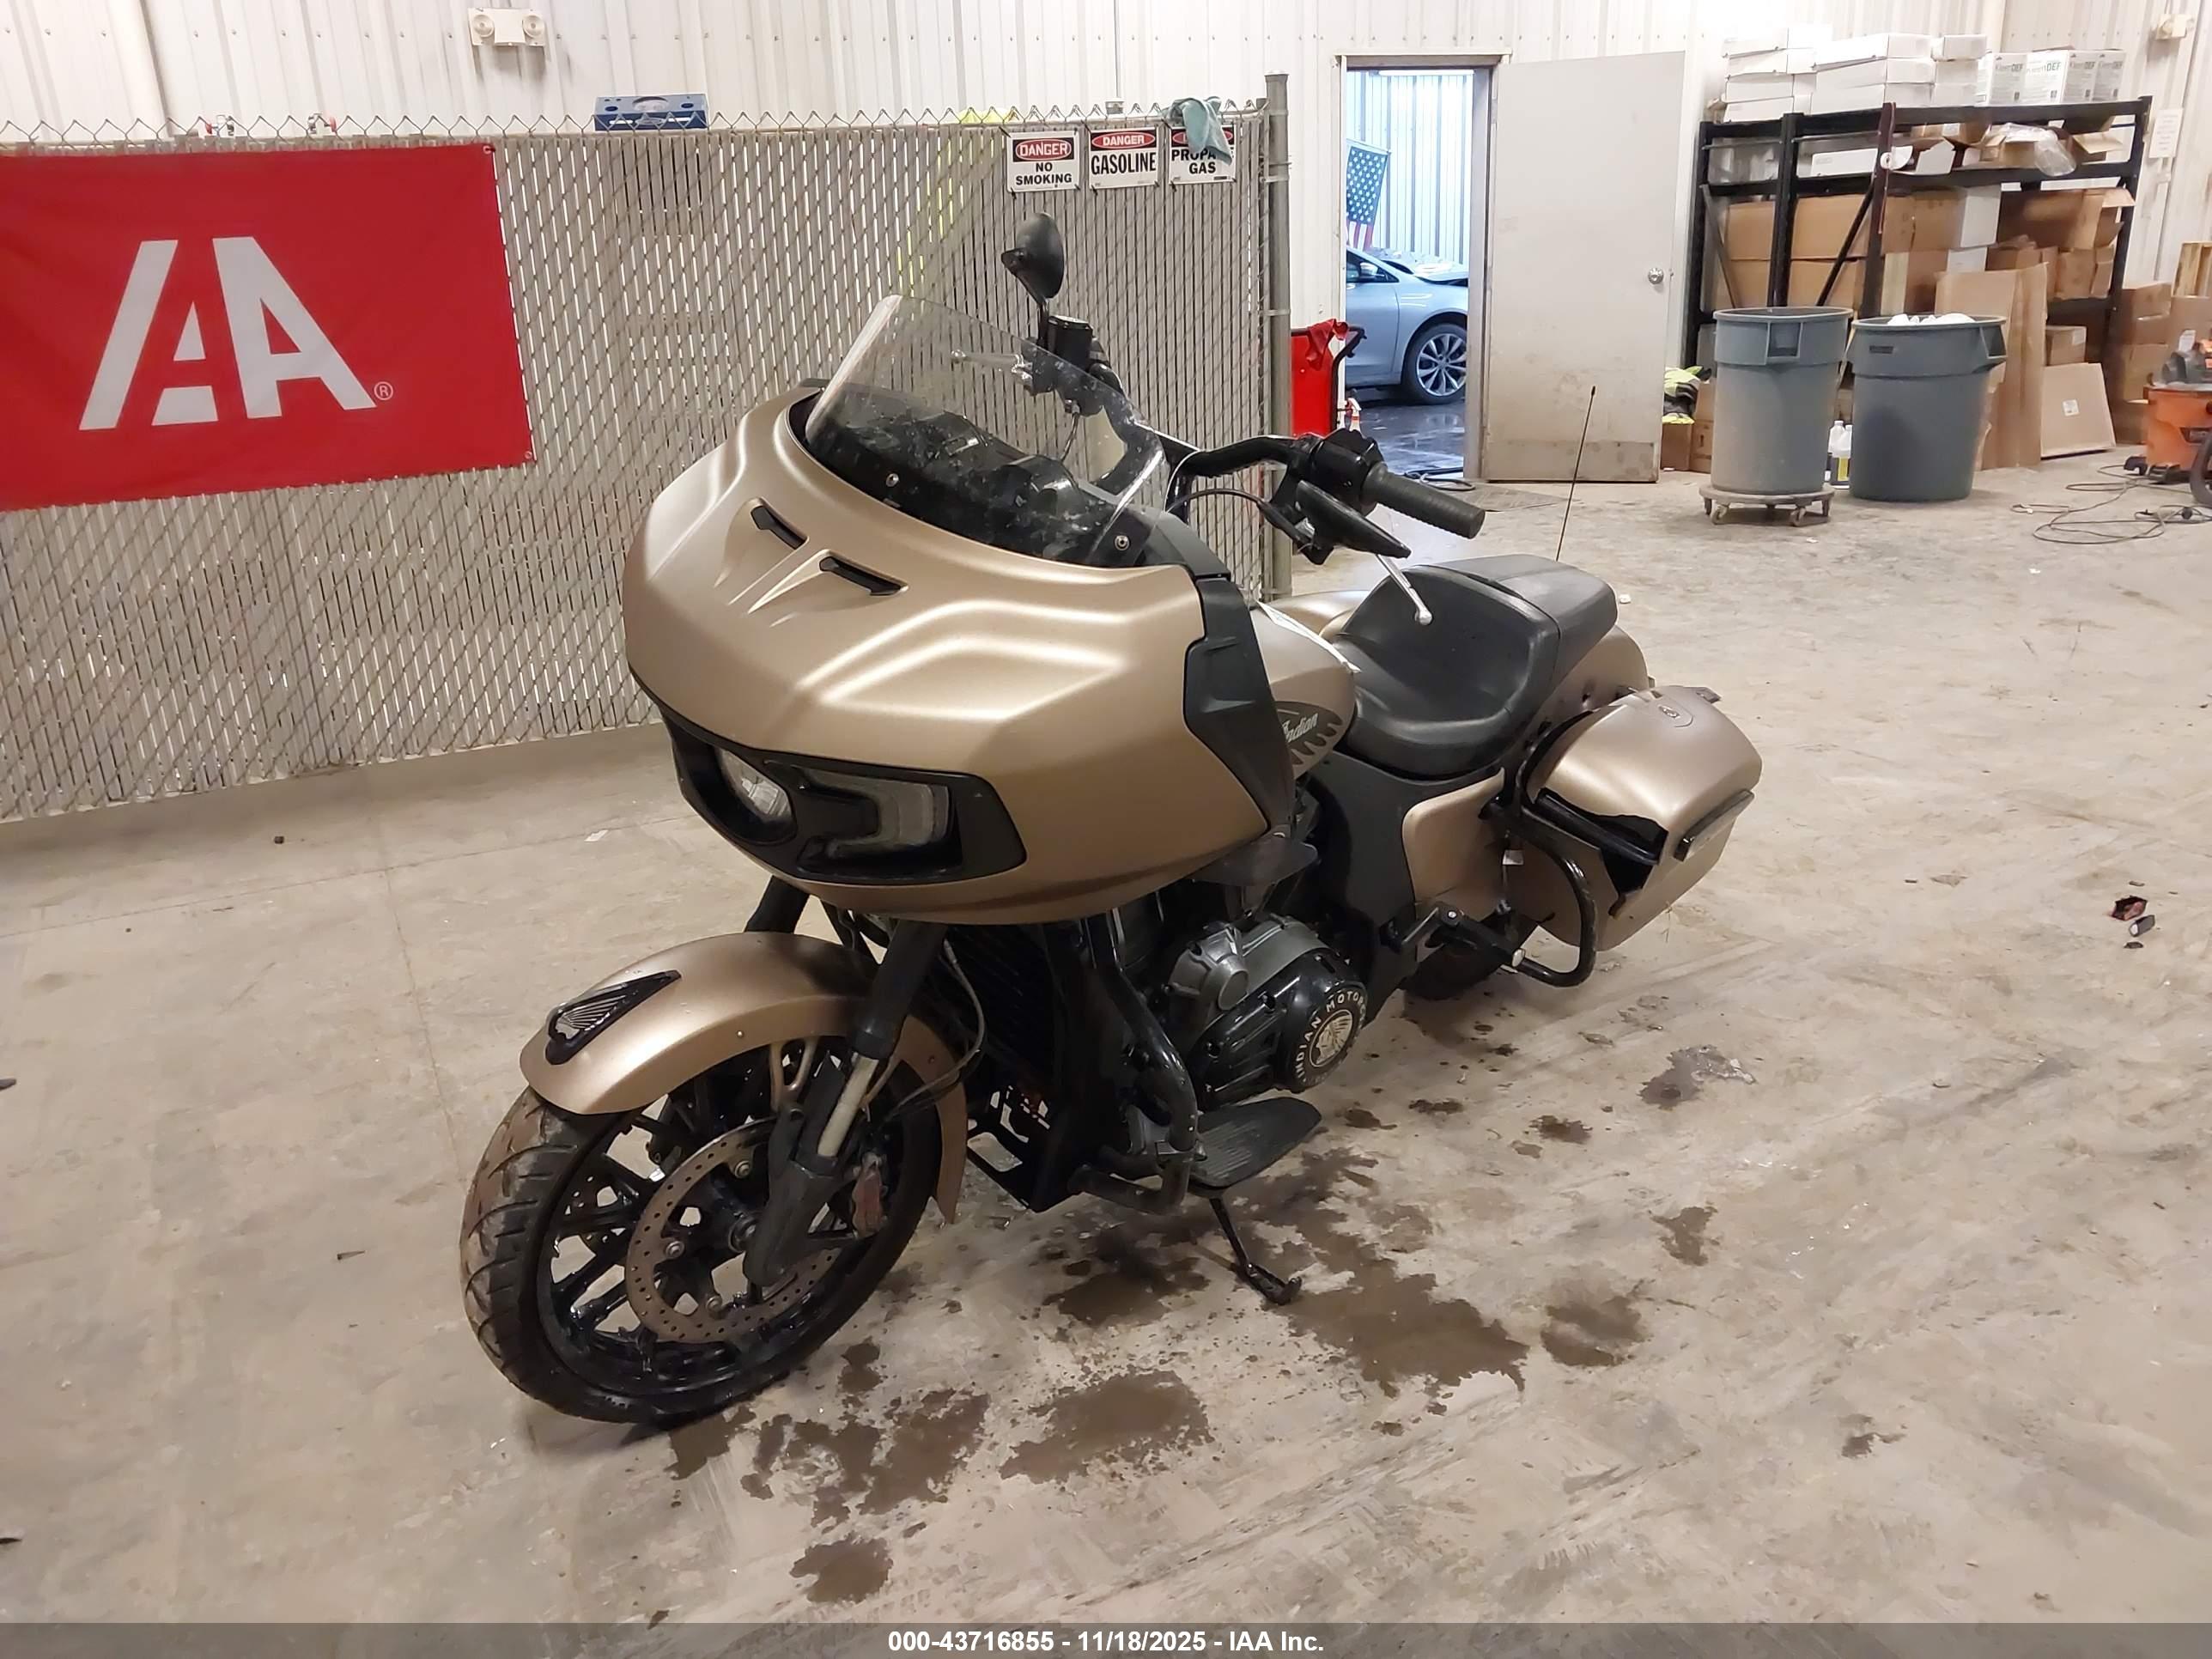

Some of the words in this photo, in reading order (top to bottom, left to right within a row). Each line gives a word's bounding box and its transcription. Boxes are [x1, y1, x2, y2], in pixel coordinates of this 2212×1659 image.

[1103, 135, 1145, 147] DANGER
[1020, 142, 1068, 156] DANGER
[1171, 147, 1234, 161] PROPA
[1036, 162, 1053, 172] NO
[1091, 152, 1157, 175] GASOLINE
[1189, 161, 1216, 174] GAS
[1016, 173, 1073, 185] SMOKING
[1282, 713, 1319, 743] Indian
[1295, 1016, 1322, 1079] INDIAN
[1326, 991, 1366, 1022] MOTORC
